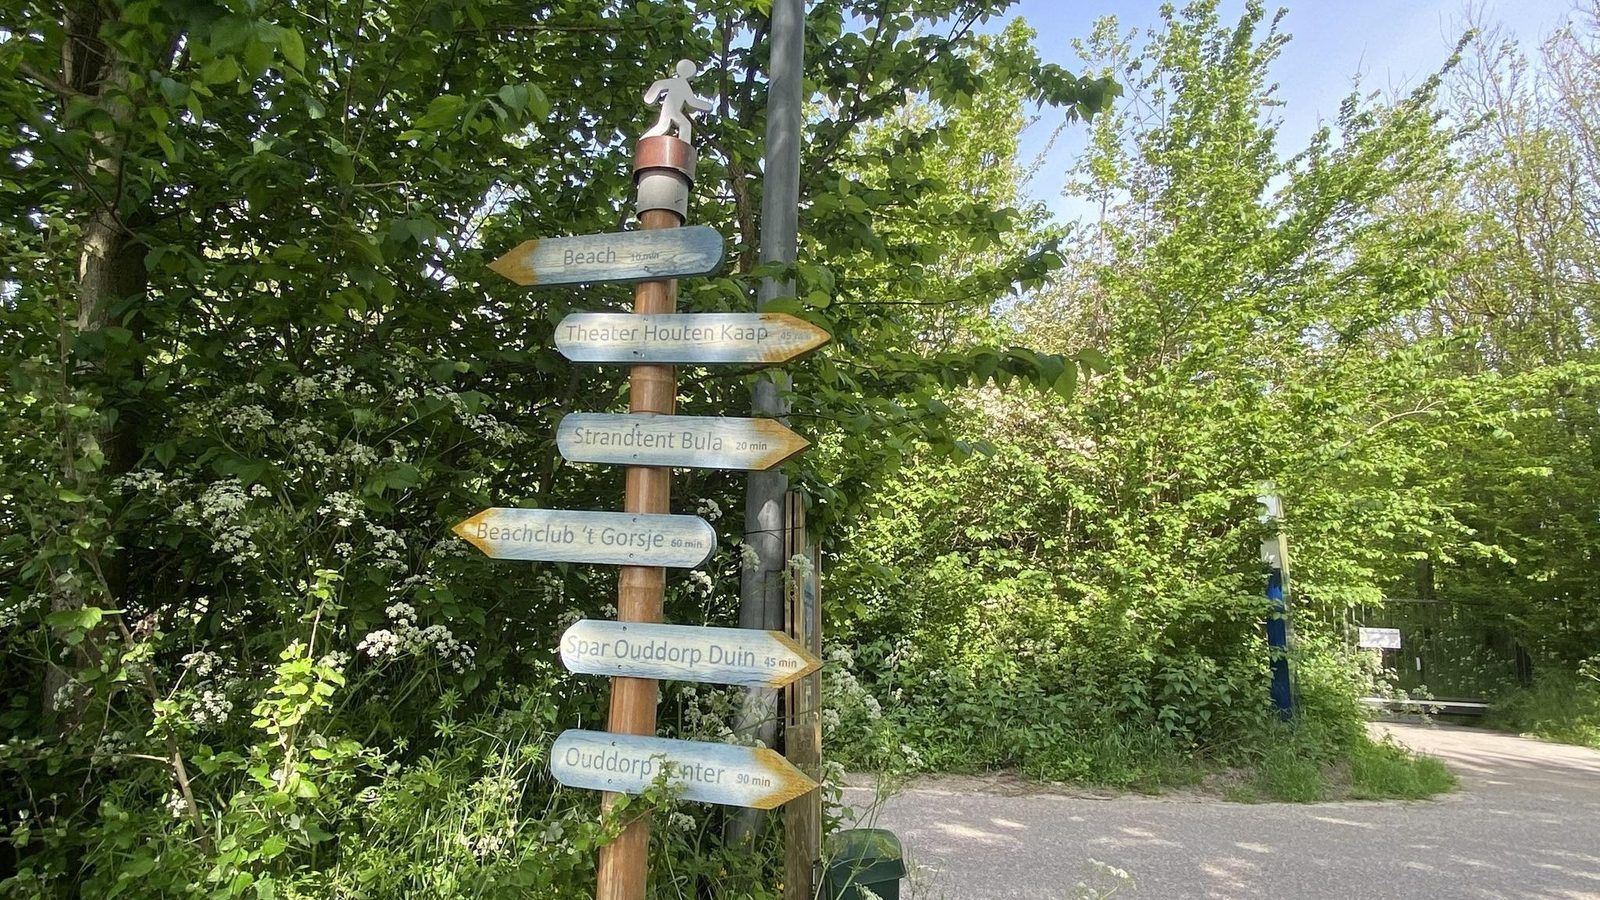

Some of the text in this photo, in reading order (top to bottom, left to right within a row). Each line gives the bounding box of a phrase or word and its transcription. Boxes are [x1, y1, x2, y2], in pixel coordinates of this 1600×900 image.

[564, 247, 616, 265] Beach
[566, 325, 639, 341] Theater
[645, 325, 714, 341] Houten
[721, 325, 768, 344] Kaap
[574, 427, 767, 451] Strandtent Bula 20 min
[477, 523, 574, 544] Beachclub
[601, 527, 665, 551] Gorsje
[671, 538, 682, 548] 60
[684, 539, 703, 548] min
[567, 635, 797, 668] Spar Ouddorp Duin 45 min
[566, 747, 652, 779] Ouddorp
[737, 774, 748, 785] 90
[752, 775, 771, 787] min
